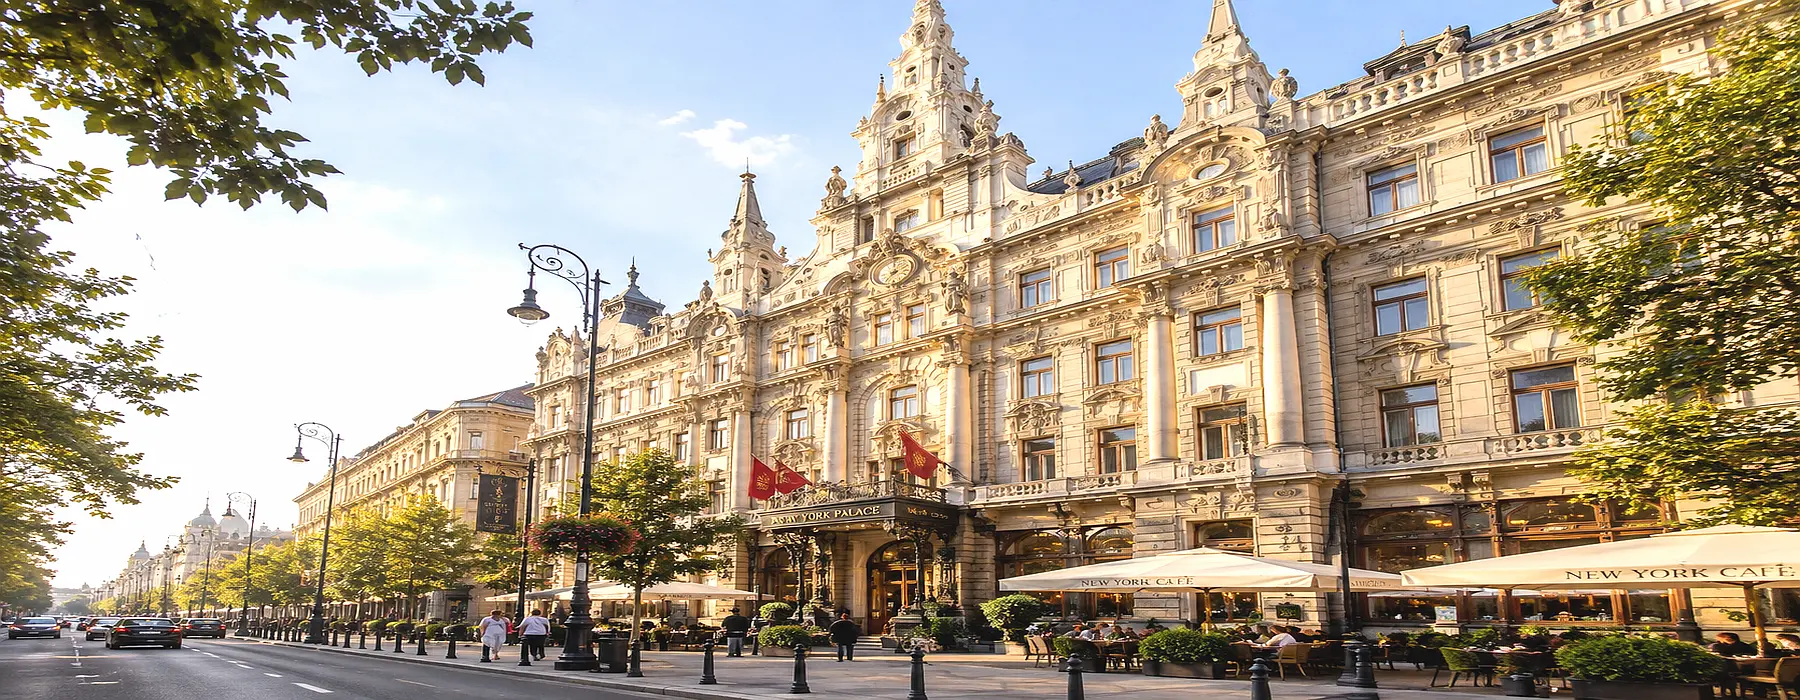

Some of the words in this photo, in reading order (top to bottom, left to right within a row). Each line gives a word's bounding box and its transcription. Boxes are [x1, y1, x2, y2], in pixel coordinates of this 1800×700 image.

[801, 511, 831, 522] YORK
[834, 505, 880, 518] PALACE
[1565, 570, 1622, 580] NEW
[1632, 568, 1709, 579] YORK
[1081, 579, 1109, 587] NEW
